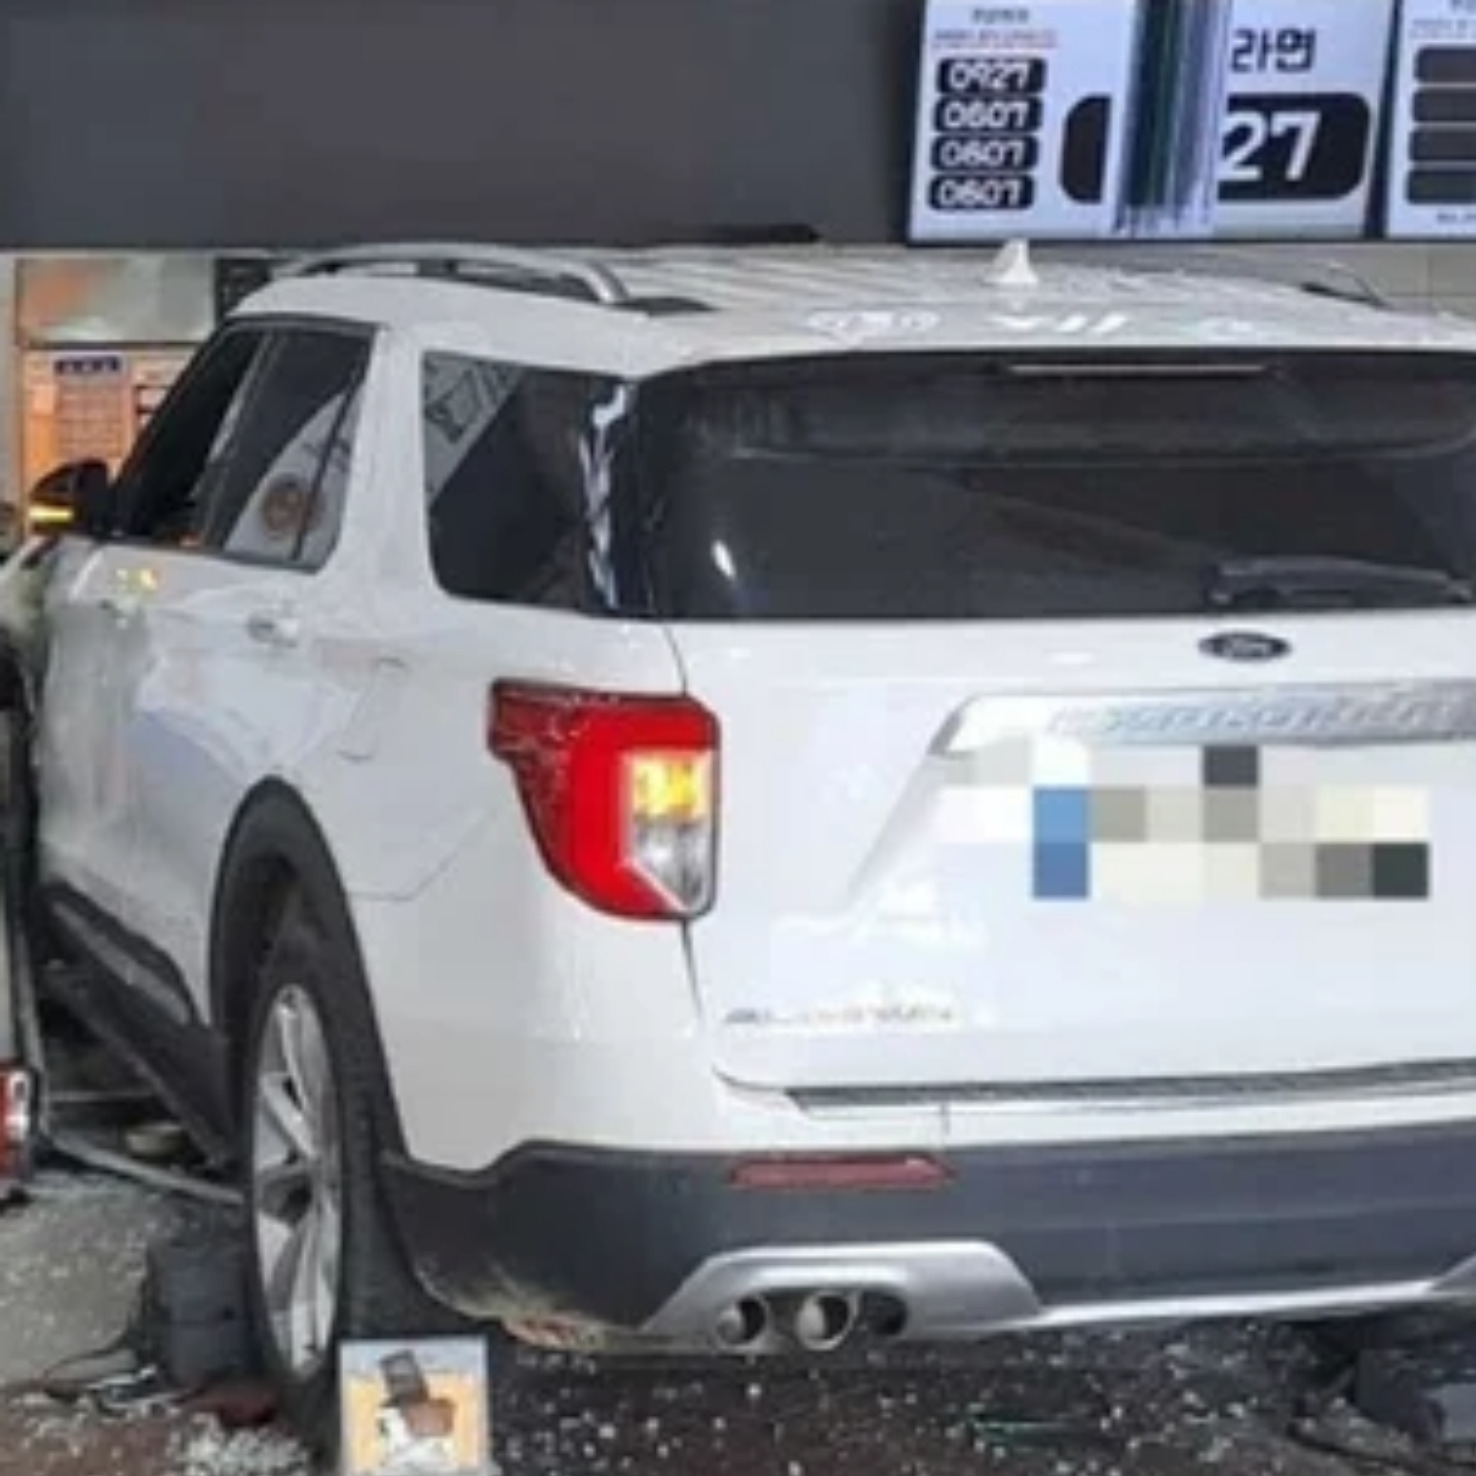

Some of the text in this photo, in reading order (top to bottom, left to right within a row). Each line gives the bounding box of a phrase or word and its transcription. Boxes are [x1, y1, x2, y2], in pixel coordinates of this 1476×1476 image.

[1231, 28, 1316, 74] 라면
[949, 61, 1030, 89] 0927
[1221, 110, 1322, 182] 27
